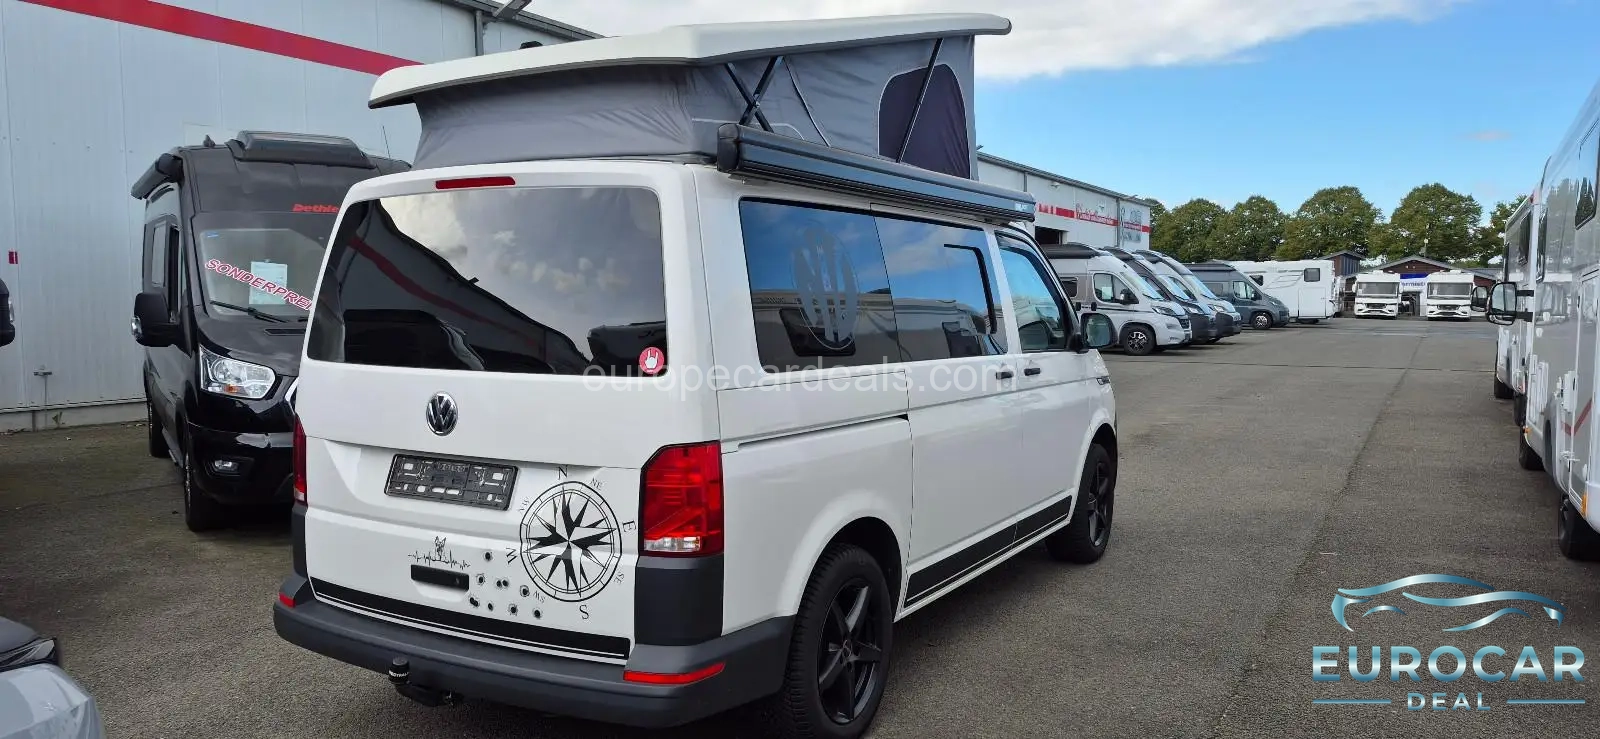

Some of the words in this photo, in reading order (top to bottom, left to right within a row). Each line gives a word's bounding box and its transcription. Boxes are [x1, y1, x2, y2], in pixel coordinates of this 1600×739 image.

[557, 465, 568, 480] N
[590, 477, 604, 491] NE
[622, 520, 636, 533] E
[579, 604, 590, 620] S
